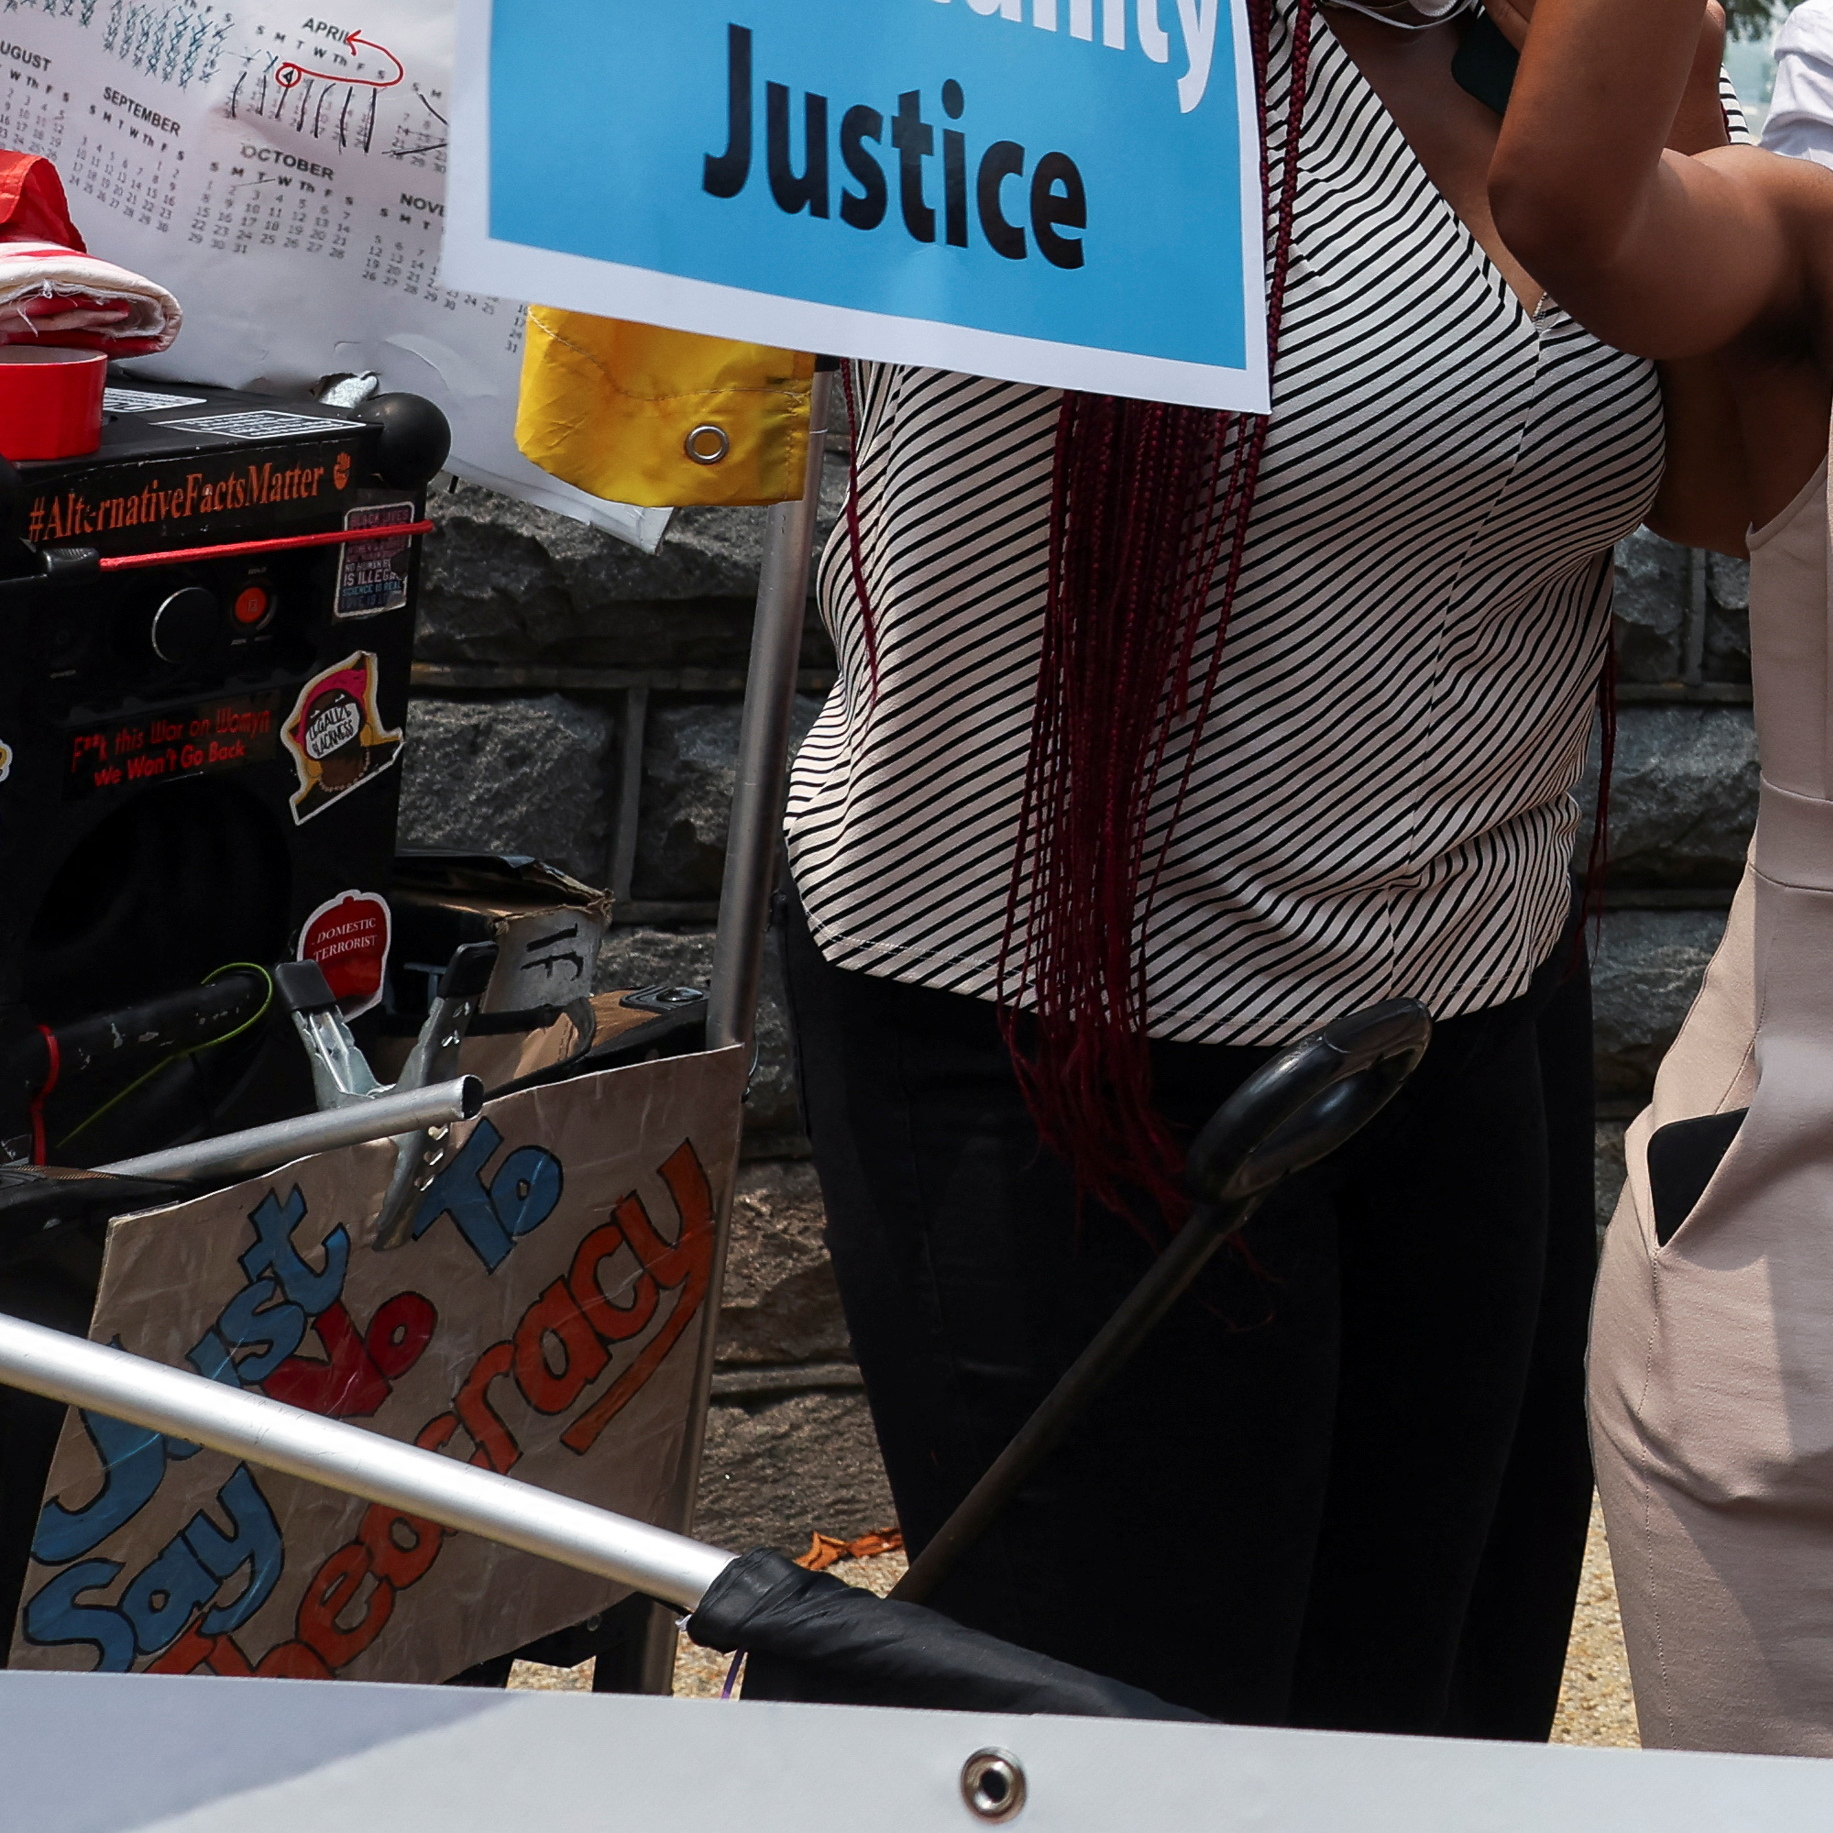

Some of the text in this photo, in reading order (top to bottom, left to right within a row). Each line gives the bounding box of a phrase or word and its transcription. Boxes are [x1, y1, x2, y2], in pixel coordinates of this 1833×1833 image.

[0, 40, 52, 72] UGUST
[103, 86, 181, 138] SEPTEMBER
[240, 144, 334, 182] OCTOBER
[702, 23, 1088, 271] Justice
[343, 573, 354, 587] IS
[113, 726, 146, 756] this
[189, 718, 212, 737] on
[126, 748, 178, 781] Won't
[179, 743, 204, 770] Go
[208, 738, 247, 764] Back
[313, 933, 379, 964] TERRORIST
[316, 917, 377, 943] DOMESTIC
[22, 1461, 284, 1673] Say
[411, 1116, 564, 1275] To
